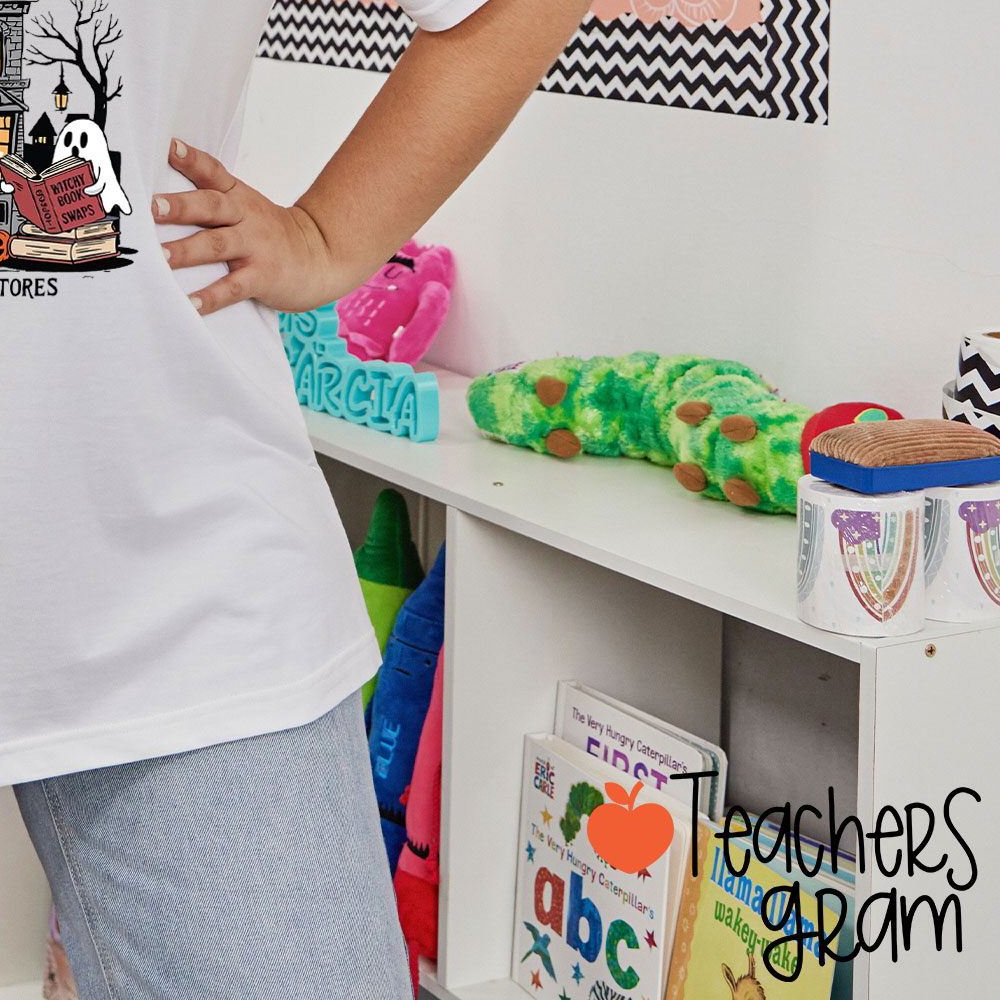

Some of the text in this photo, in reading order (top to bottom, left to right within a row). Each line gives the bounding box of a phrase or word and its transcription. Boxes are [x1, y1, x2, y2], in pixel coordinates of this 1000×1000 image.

[50, 173, 86, 195] WITCHY
[57, 189, 86, 207] BOOK
[61, 204, 96, 225] SWAPS
[288, 349, 418, 436] ARCIA
[376, 714, 401, 779] BLUE
[572, 706, 688, 775] The Very Hungry Caterpillar's
[533, 775, 555, 800] CARLE
[534, 761, 556, 786] ERIC
[531, 822, 655, 920] The Very Hungry Caterpillar's
[534, 867, 640, 990] abc
